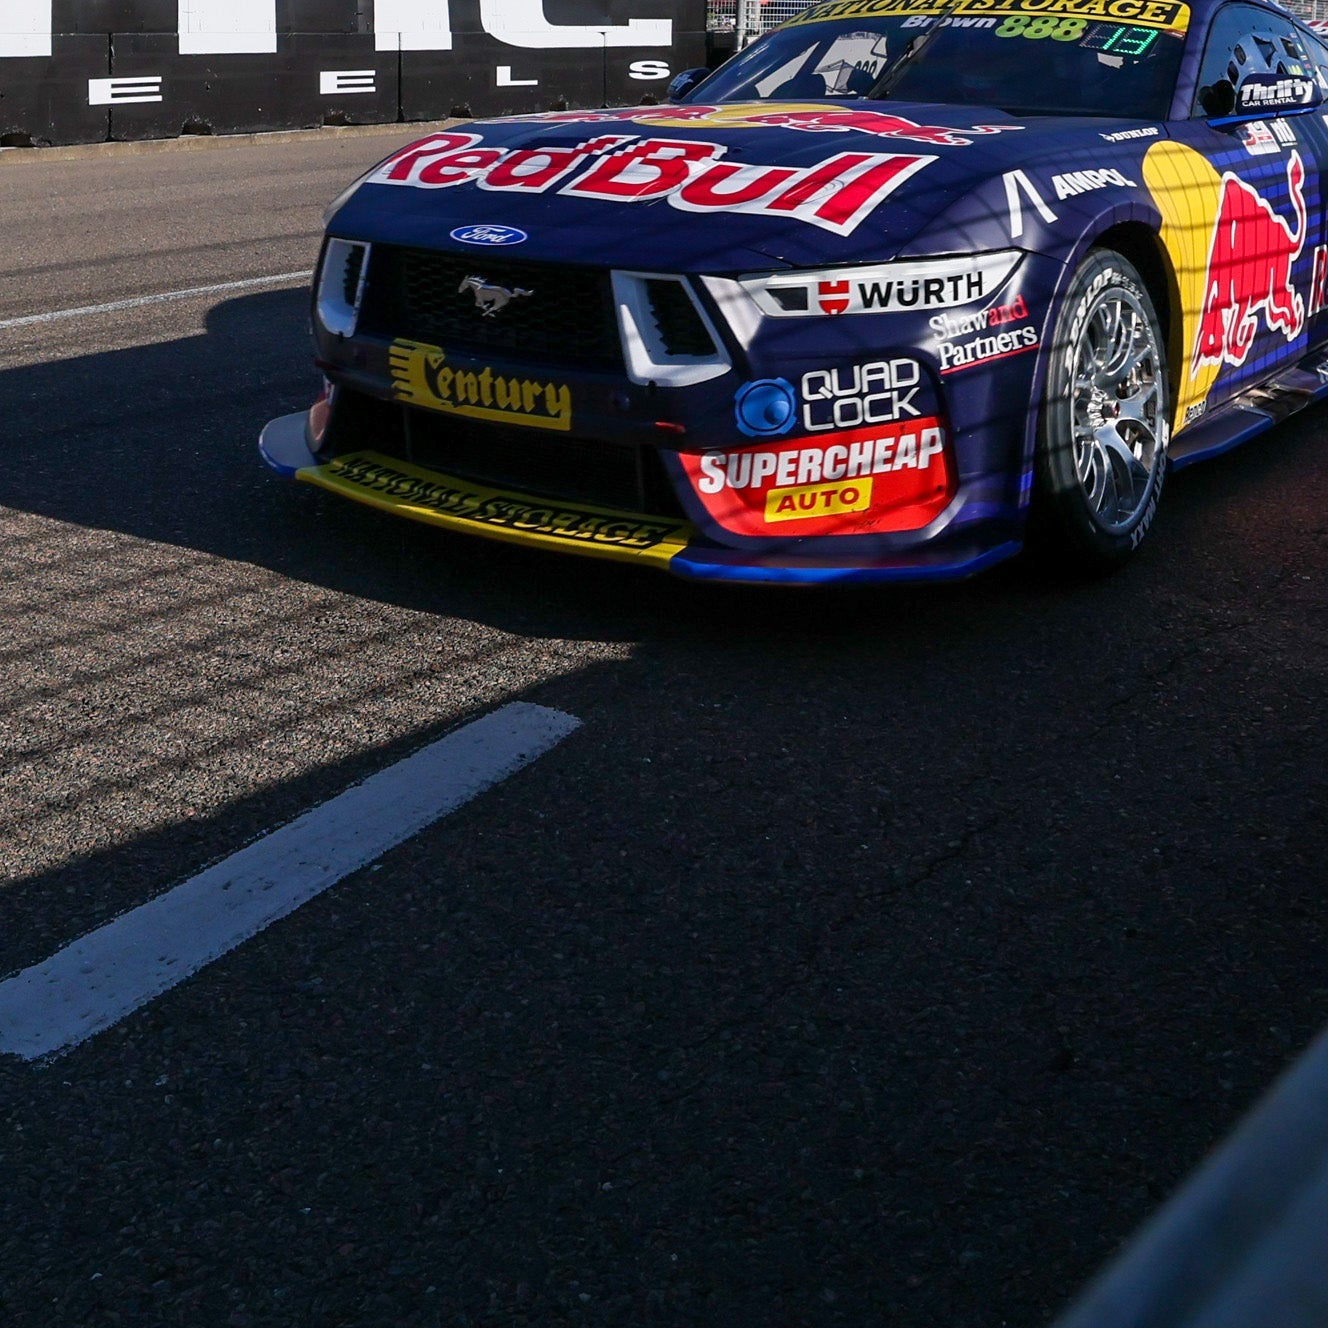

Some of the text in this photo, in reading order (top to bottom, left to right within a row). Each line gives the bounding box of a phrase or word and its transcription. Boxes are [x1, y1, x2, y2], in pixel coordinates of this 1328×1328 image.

[994, 15, 1088, 42] 888
[1240, 78, 1314, 104] Thrifty
[1242, 97, 1297, 107] CAR RENTAL
[1111, 127, 1159, 141] DUNLOP
[369, 133, 940, 238] Red Bull
[1051, 168, 1138, 201] AMPOL
[460, 226, 514, 243] Ford
[858, 271, 983, 309] WÜRTH
[937, 326, 1039, 370] Partners
[389, 338, 572, 432] Century
[801, 358, 920, 401] QUAD
[803, 387, 922, 432] LOCK
[698, 426, 946, 494] SUPERCHEAP
[330, 457, 665, 547] NATIONAL STORAGE
[775, 487, 860, 513] AUTO
